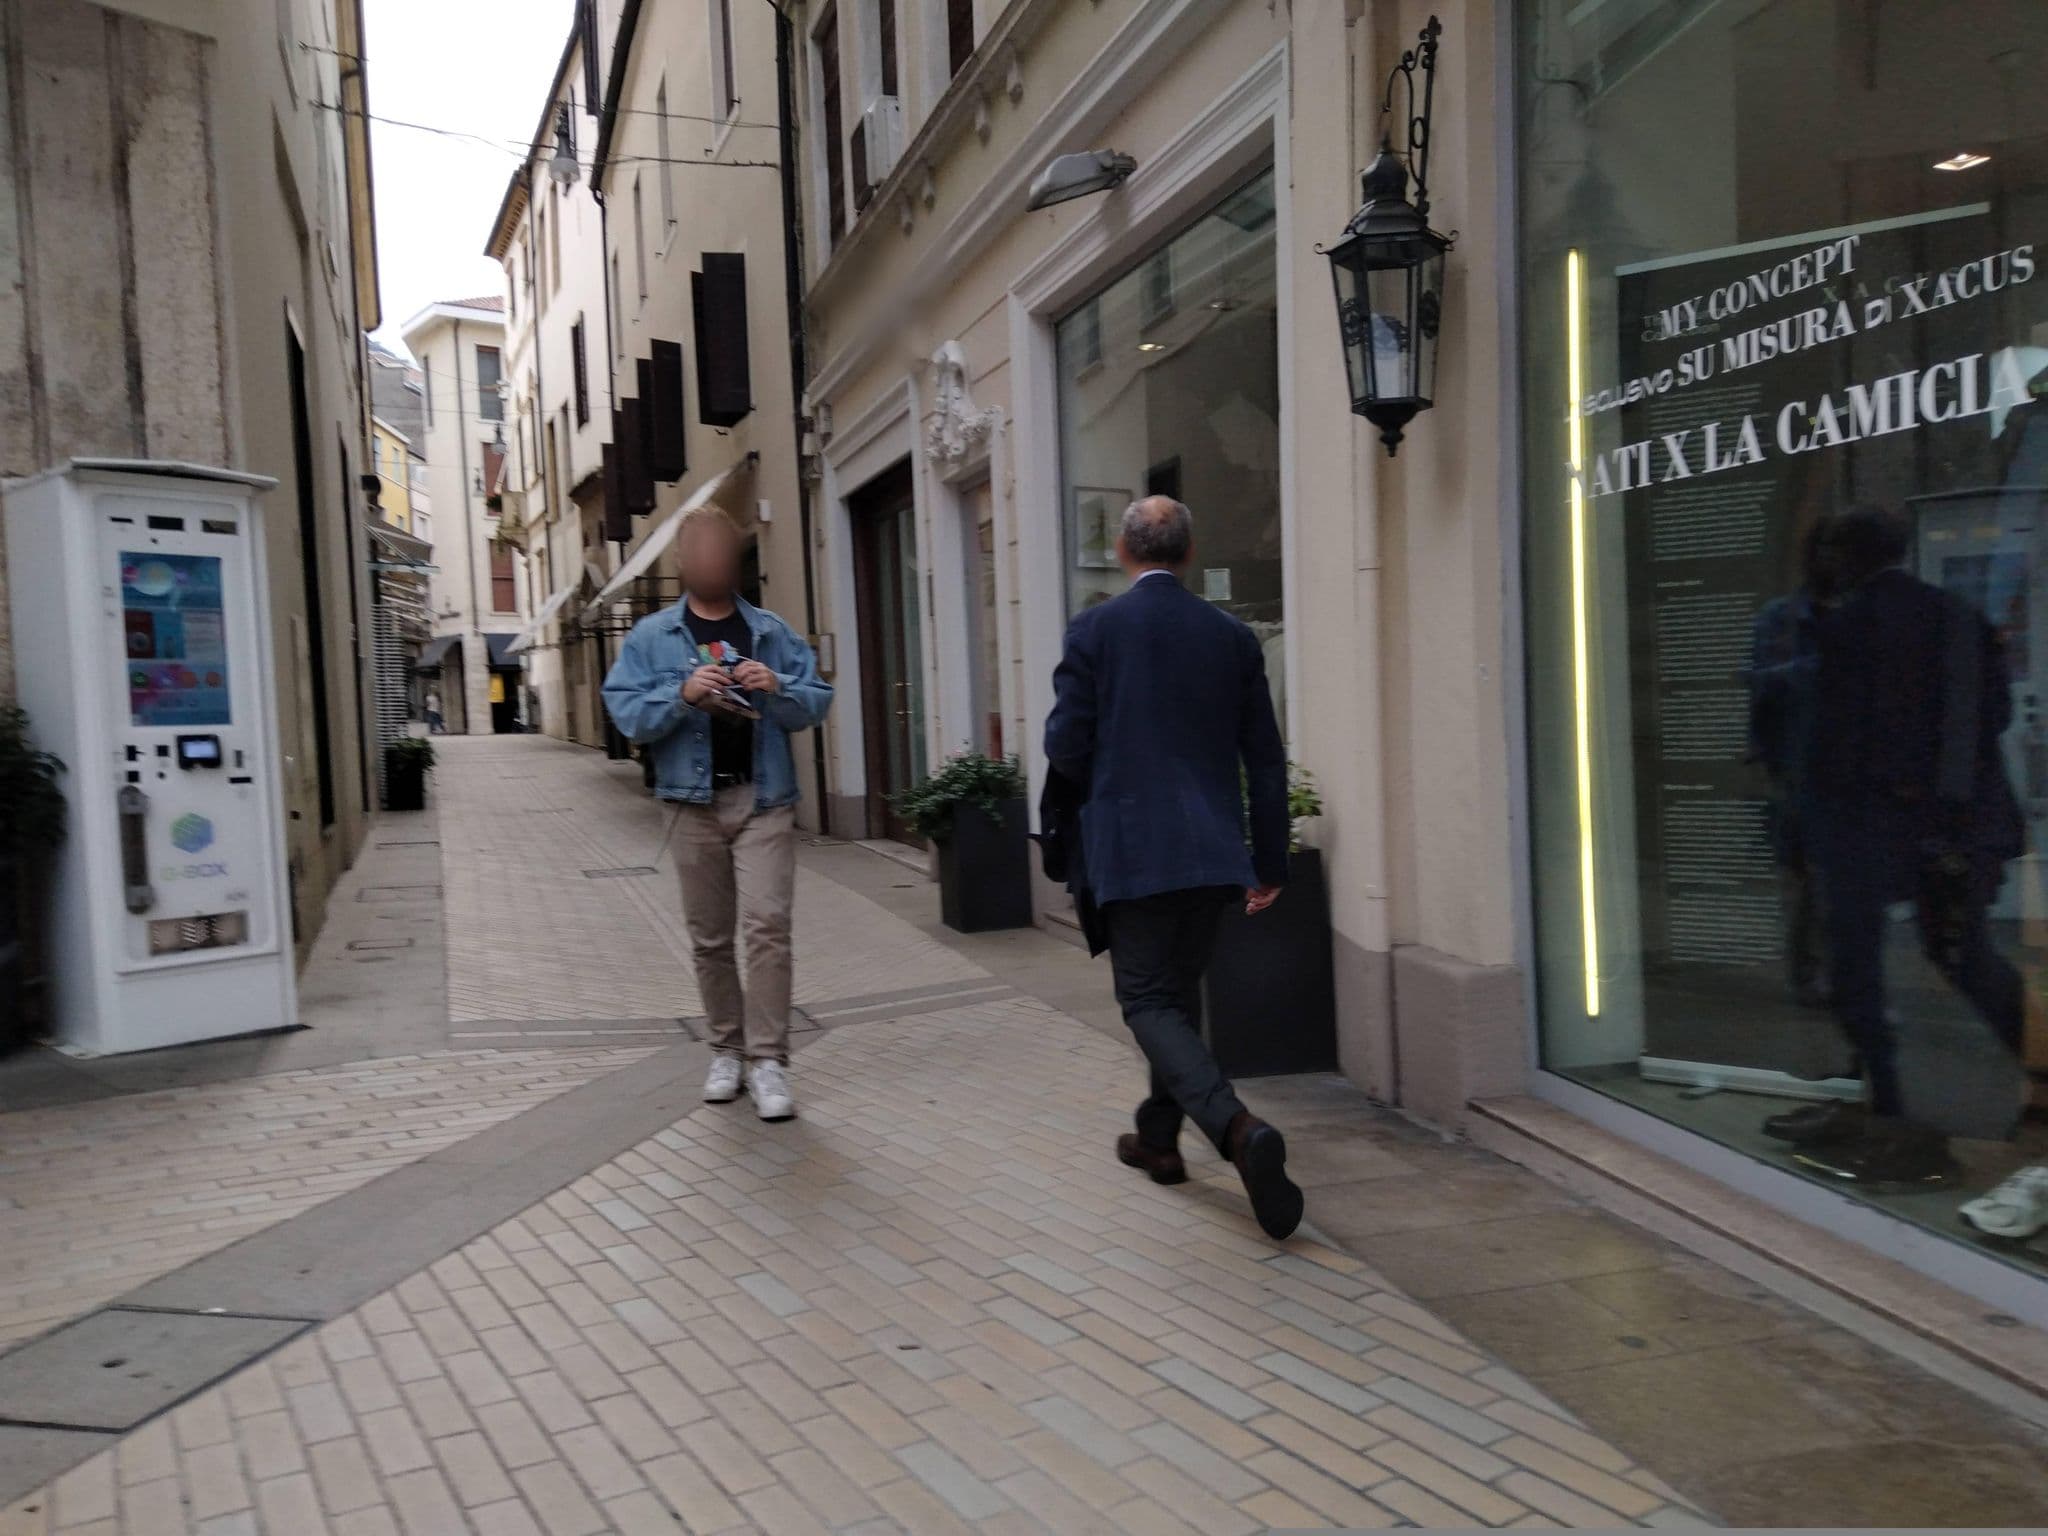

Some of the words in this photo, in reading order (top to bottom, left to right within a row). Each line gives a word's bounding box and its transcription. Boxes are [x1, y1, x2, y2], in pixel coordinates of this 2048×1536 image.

[1660, 295, 1704, 340] MY
[1708, 235, 1861, 311] CONCEPT
[1678, 343, 1717, 387] SU
[1721, 300, 1857, 374] MISURA
[1864, 294, 1892, 330] DI
[1899, 244, 2035, 319] XACUS
[1660, 429, 1694, 482] X
[1701, 414, 1768, 473] LA
[1776, 345, 2038, 456] CAMICIA
